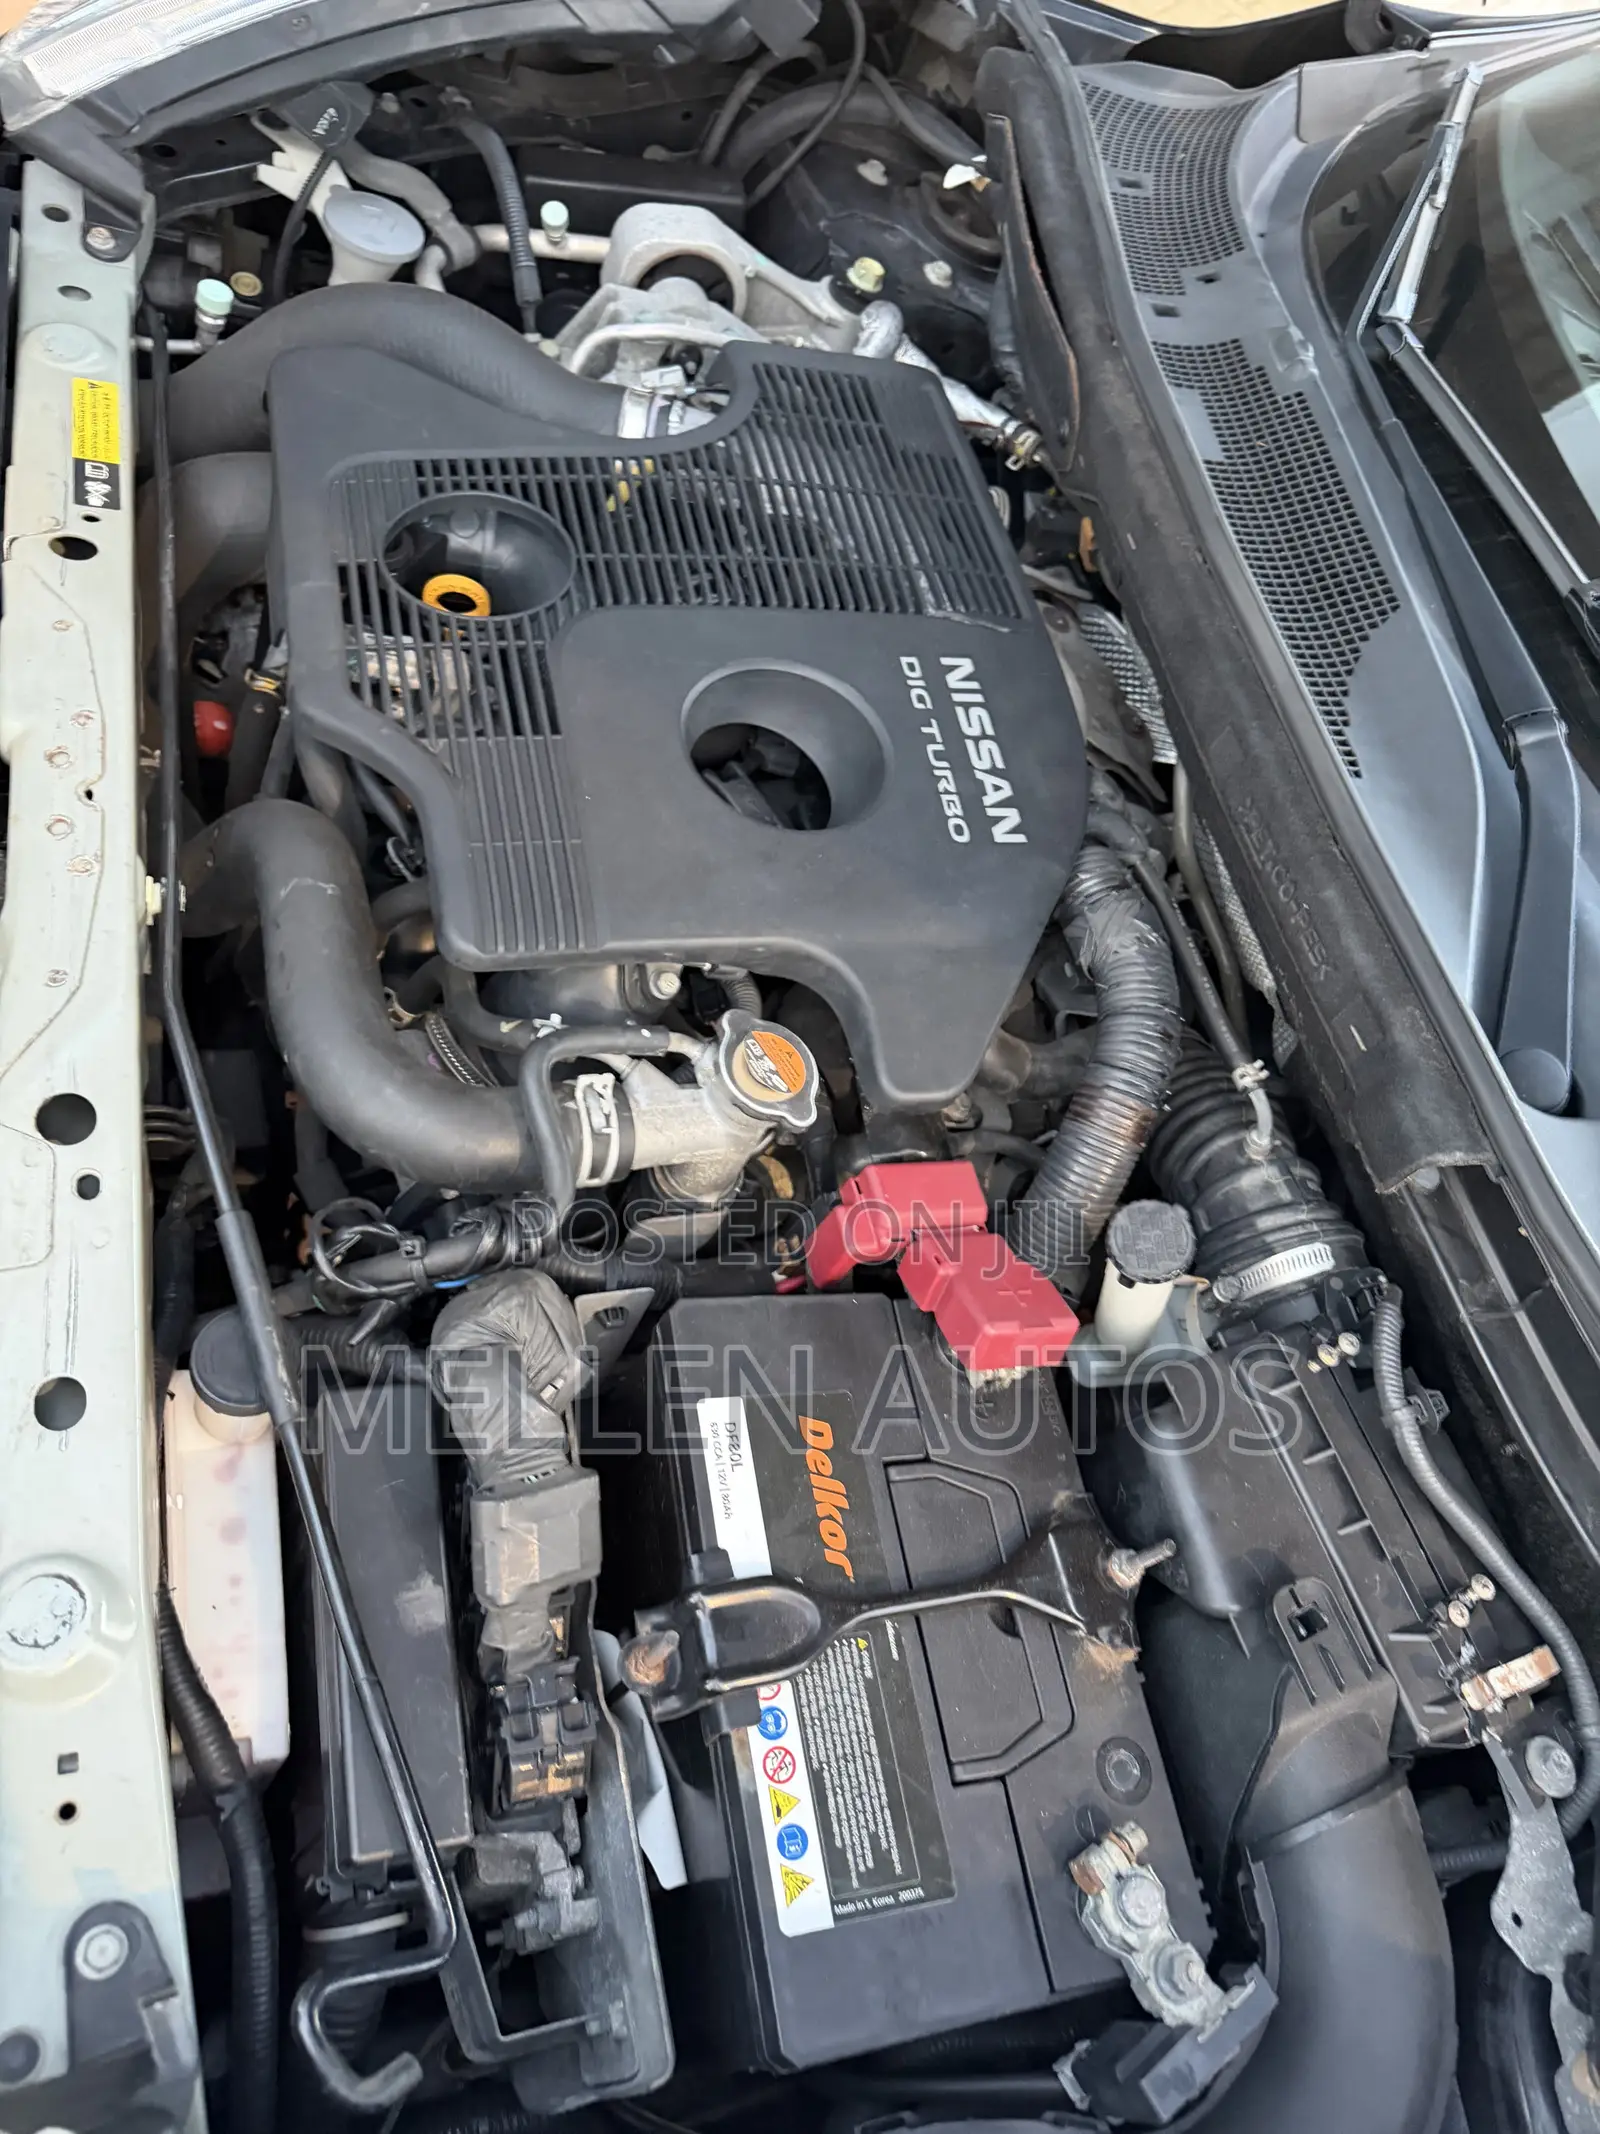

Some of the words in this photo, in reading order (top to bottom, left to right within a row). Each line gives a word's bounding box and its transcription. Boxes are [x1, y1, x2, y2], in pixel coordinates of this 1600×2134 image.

[900, 656, 933, 710] DIG
[920, 718, 971, 843] TURBO
[939, 656, 1028, 843] NISSAN
[724, 1422, 743, 1472] DF80L
[798, 1415, 854, 1578] Delkor
